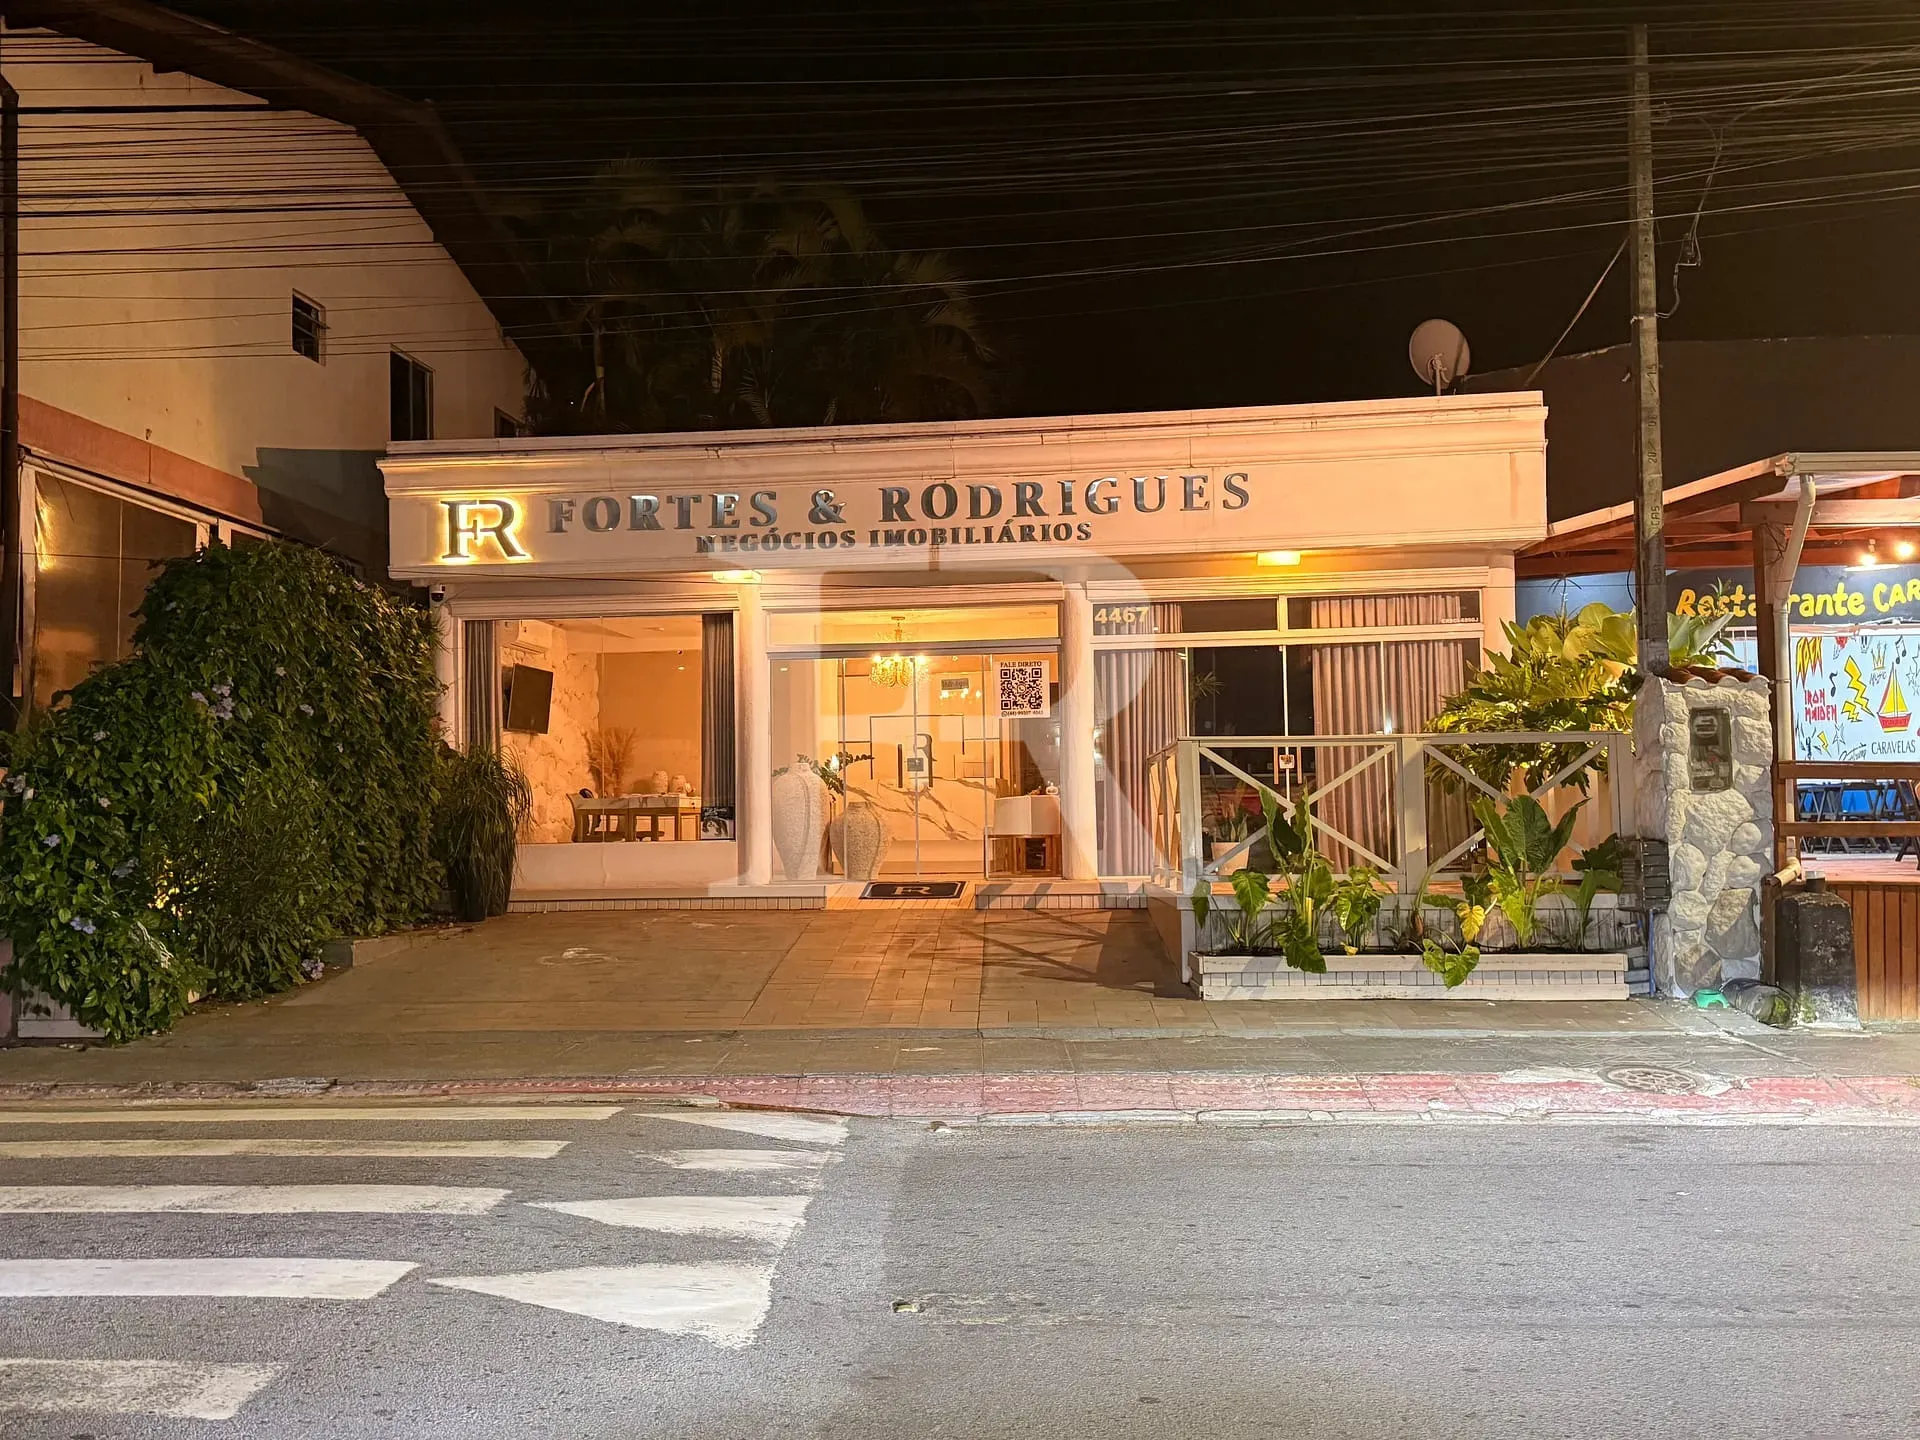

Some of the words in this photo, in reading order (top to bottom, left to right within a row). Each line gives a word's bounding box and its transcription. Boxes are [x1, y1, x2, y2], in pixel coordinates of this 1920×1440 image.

[547, 490, 777, 533] FORTES
[808, 488, 847, 525] &
[878, 472, 1250, 523] RODRIGUES
[695, 527, 856, 553] NEGÓCIOS
[867, 519, 1093, 548] IMOBILIÁRIOS
[1094, 606, 1149, 624] 4467
[1804, 688, 1825, 707] IRON
[1804, 704, 1838, 724] MAIDEN
[1871, 739, 1916, 755] CARAVELAS
